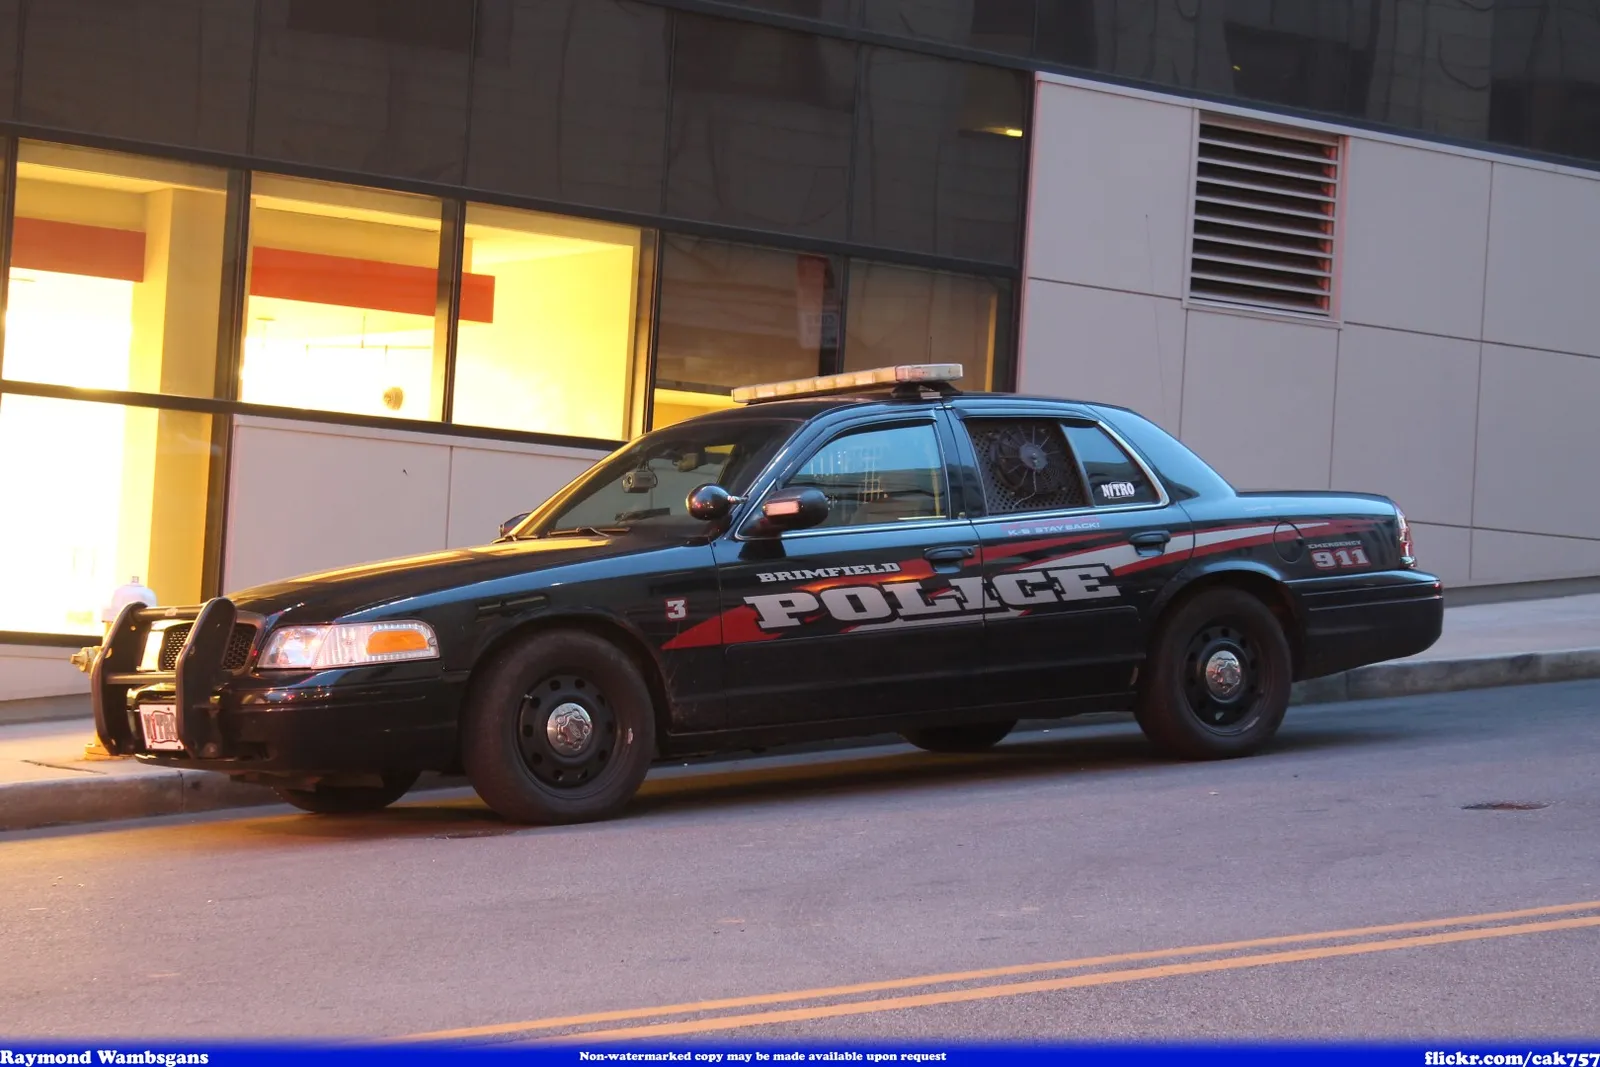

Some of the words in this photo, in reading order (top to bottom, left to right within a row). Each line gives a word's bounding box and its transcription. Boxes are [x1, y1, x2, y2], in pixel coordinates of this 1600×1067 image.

[1101, 481, 1135, 498] NITRO
[1007, 528, 1030, 536] K-9
[1035, 525, 1064, 533] STAY
[1065, 522, 1100, 531] BACK!
[1306, 540, 1361, 549] EMERGENCY
[1312, 548, 1369, 568] 911
[756, 562, 901, 583] BRIMFIELD
[743, 565, 1121, 629] POLICE
[667, 599, 686, 619] 3
